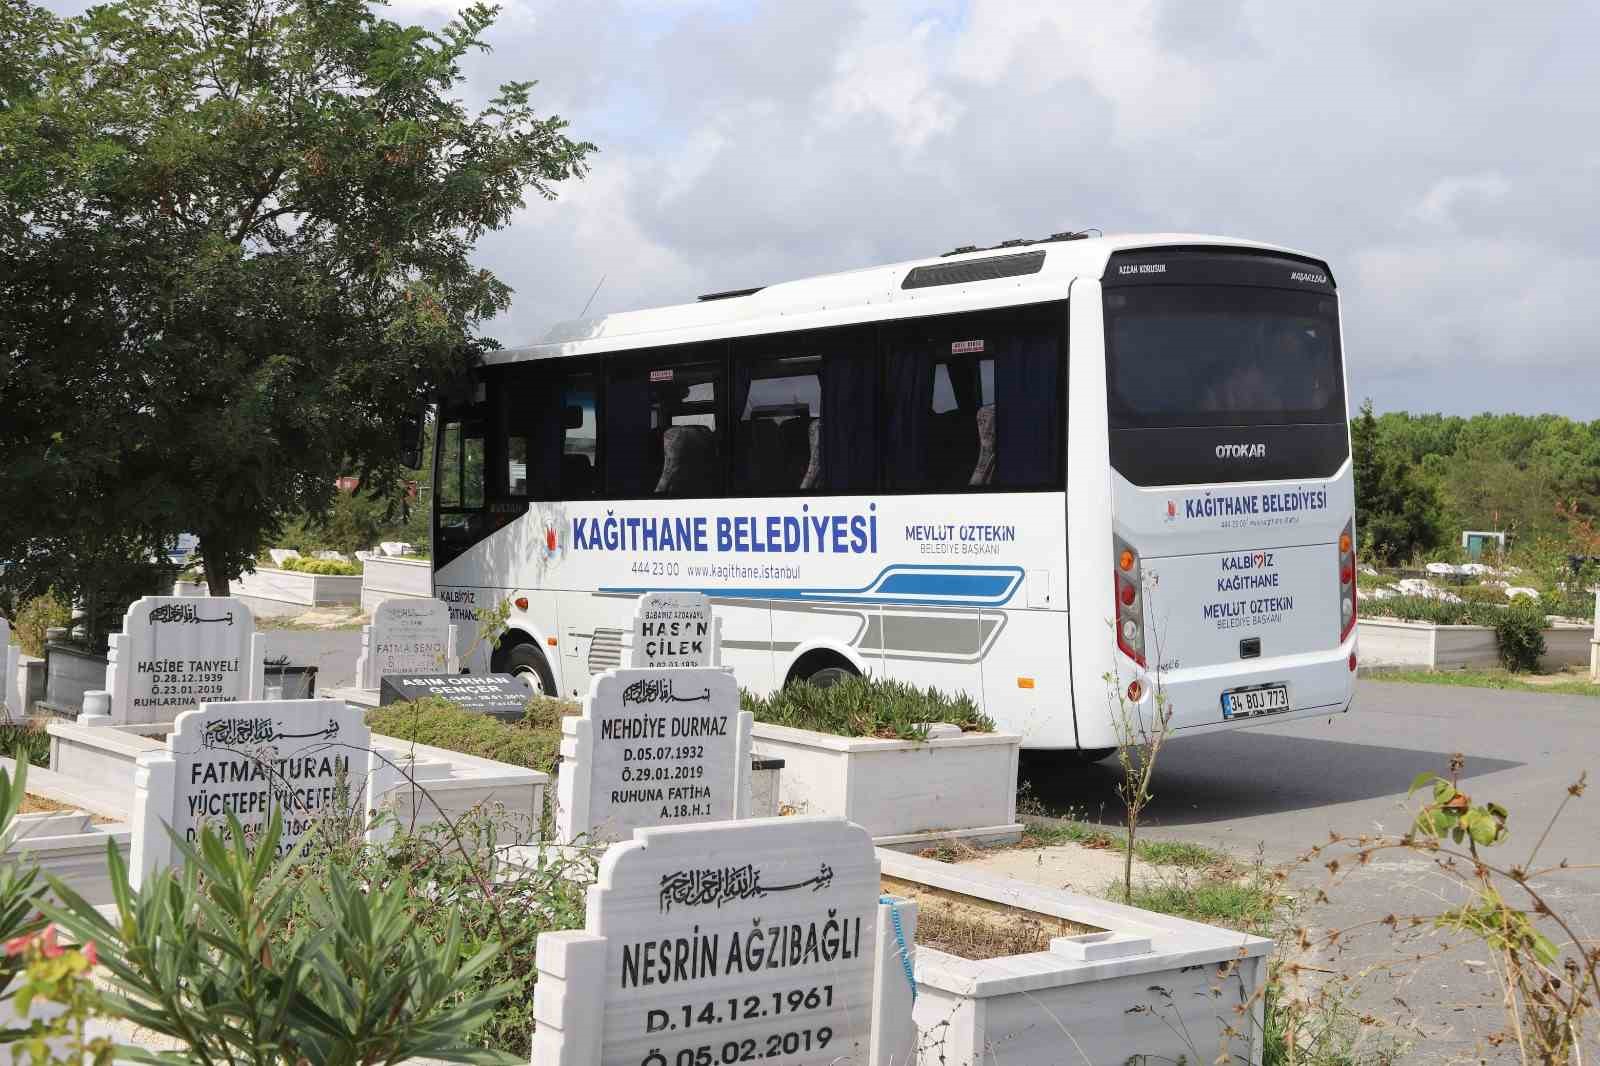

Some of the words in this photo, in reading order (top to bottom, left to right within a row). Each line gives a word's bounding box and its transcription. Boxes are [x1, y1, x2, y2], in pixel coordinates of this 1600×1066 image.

[1215, 443, 1266, 458] OTOKAR
[1185, 491, 1259, 519] KAĞITHANE
[1262, 484, 1327, 513] BELEDİYESİ
[572, 508, 708, 551] KAĞITHANE
[716, 502, 878, 554] BELEDİYESİ
[631, 561, 650, 575] 444
[652, 561, 664, 576] 23
[666, 561, 680, 576] 00
[687, 562, 801, 582] www.kagithane.istanbul
[1217, 573, 1279, 592] KAĞITHANE
[646, 638, 703, 658] ÇİLEK
[138, 658, 184, 673] HASİBE
[188, 657, 241, 672] TANYELİ
[152, 673, 224, 683] D.28.12.1939
[402, 677, 446, 687] ASIM
[448, 676, 510, 686] ORHAN
[151, 684, 223, 695] Ö.23.01.2019
[1230, 695, 1243, 712] 34
[1267, 689, 1286, 707] 773
[601, 713, 666, 740] MEHDİYE
[671, 716, 728, 737] DURMAZ
[623, 745, 704, 762] D.05.07.1932
[191, 760, 266, 785] FATMA
[622, 765, 704, 782] Ö.29.01.2019
[611, 788, 664, 804] RUHUNA
[668, 784, 711, 800] FATİHA
[621, 924, 719, 989] NESRİN
[725, 908, 861, 975] AĞZIBAĞLI
[646, 984, 833, 1033] D.14.12.1961
